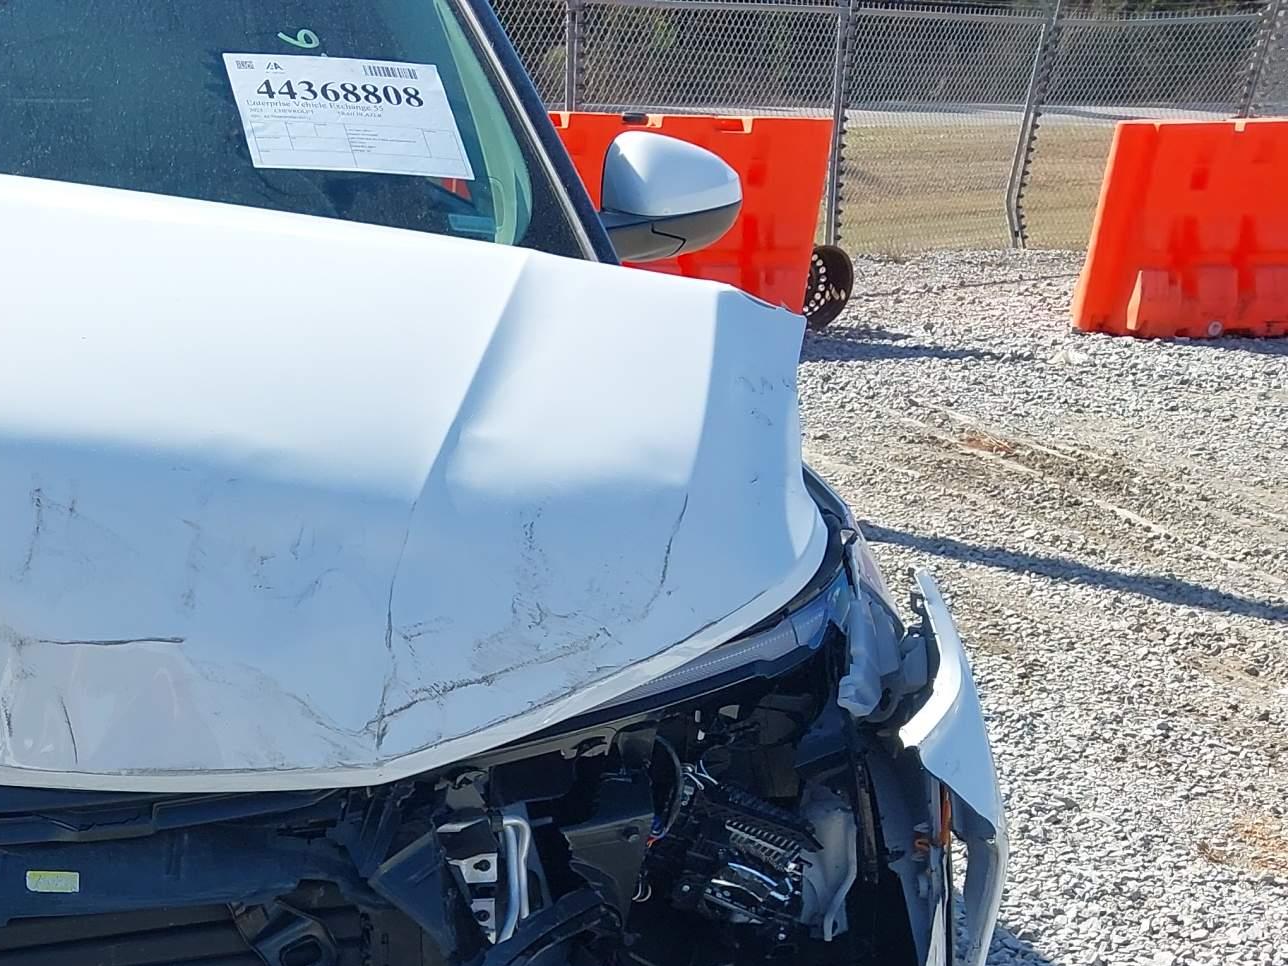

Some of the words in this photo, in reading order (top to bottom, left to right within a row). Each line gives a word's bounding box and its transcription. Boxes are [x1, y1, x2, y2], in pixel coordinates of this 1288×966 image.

[256, 79, 424, 108] 44368808
[246, 99, 291, 109] Enterprise
[293, 101, 327, 109] Vehicle
[329, 102, 371, 112] Exchange
